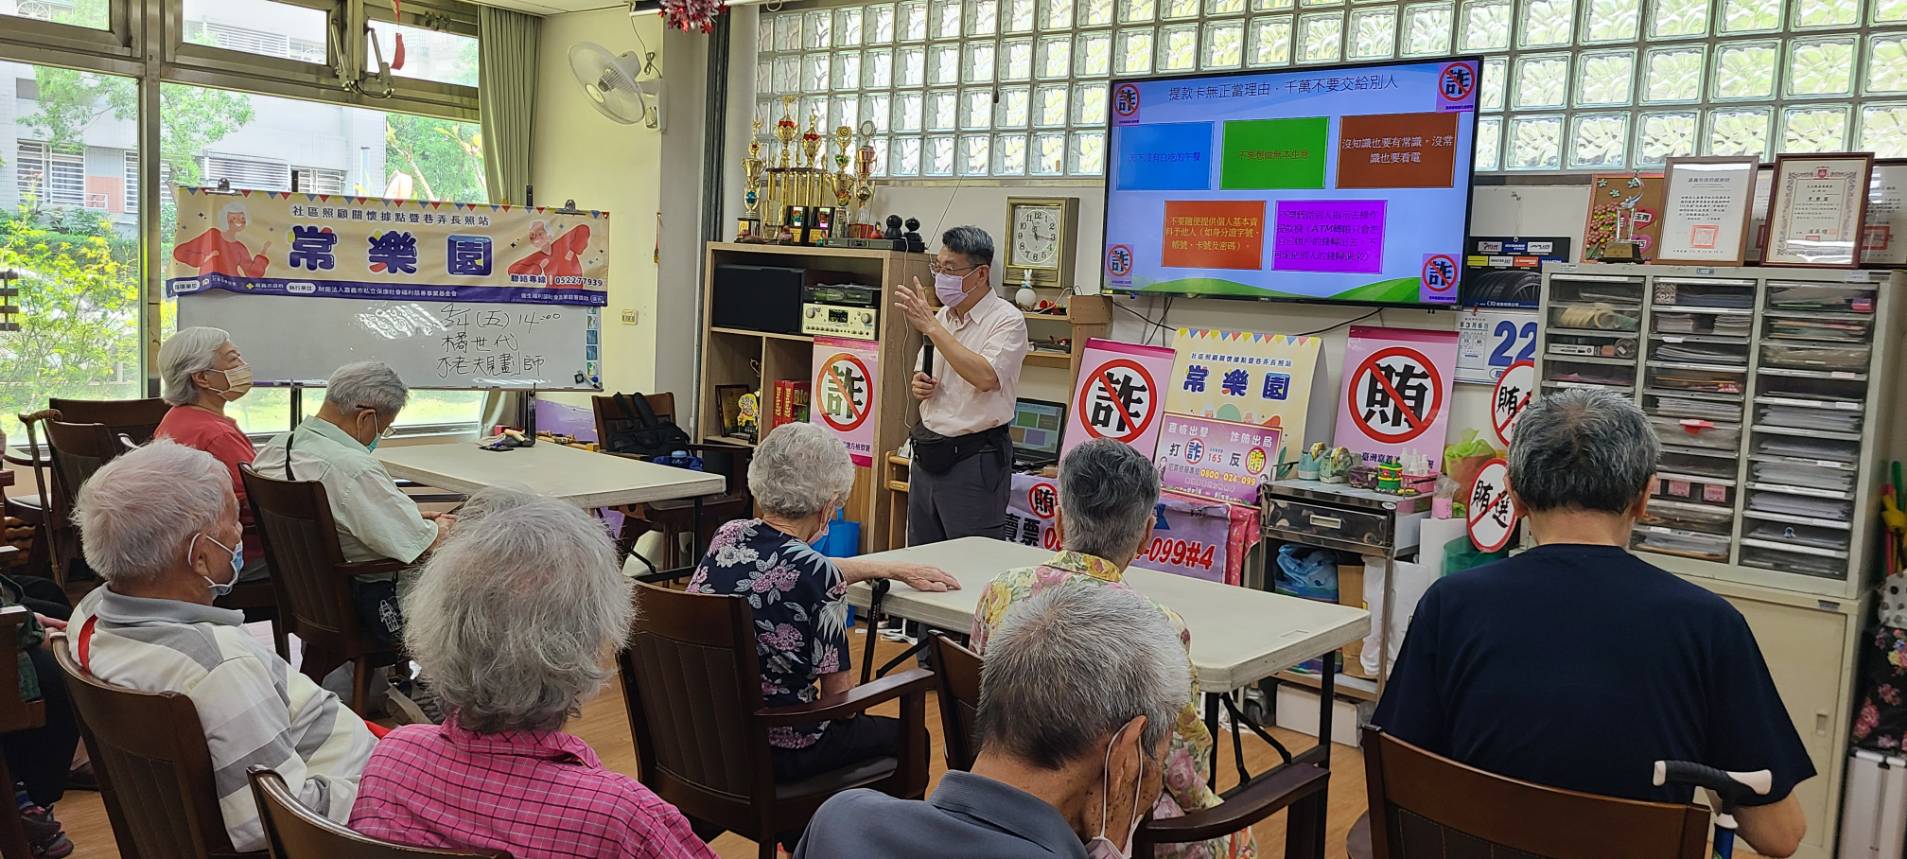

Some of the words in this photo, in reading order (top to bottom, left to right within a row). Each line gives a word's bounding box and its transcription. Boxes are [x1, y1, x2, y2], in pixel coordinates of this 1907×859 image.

[292, 206, 490, 227] 社區照顧關懷據點暨巷弄長照站
[290, 226, 492, 276] 常樂園
[510, 274, 546, 283] 聯絡專線
[1488, 320, 1538, 367] 22
[436, 352, 546, 379] 不老規劃師
[1183, 364, 1291, 401] 常樂園
[827, 364, 865, 418] 詐
[1091, 372, 1148, 432] 詐
[1363, 364, 1430, 428] 賄
[1208, 453, 1222, 464] 165
